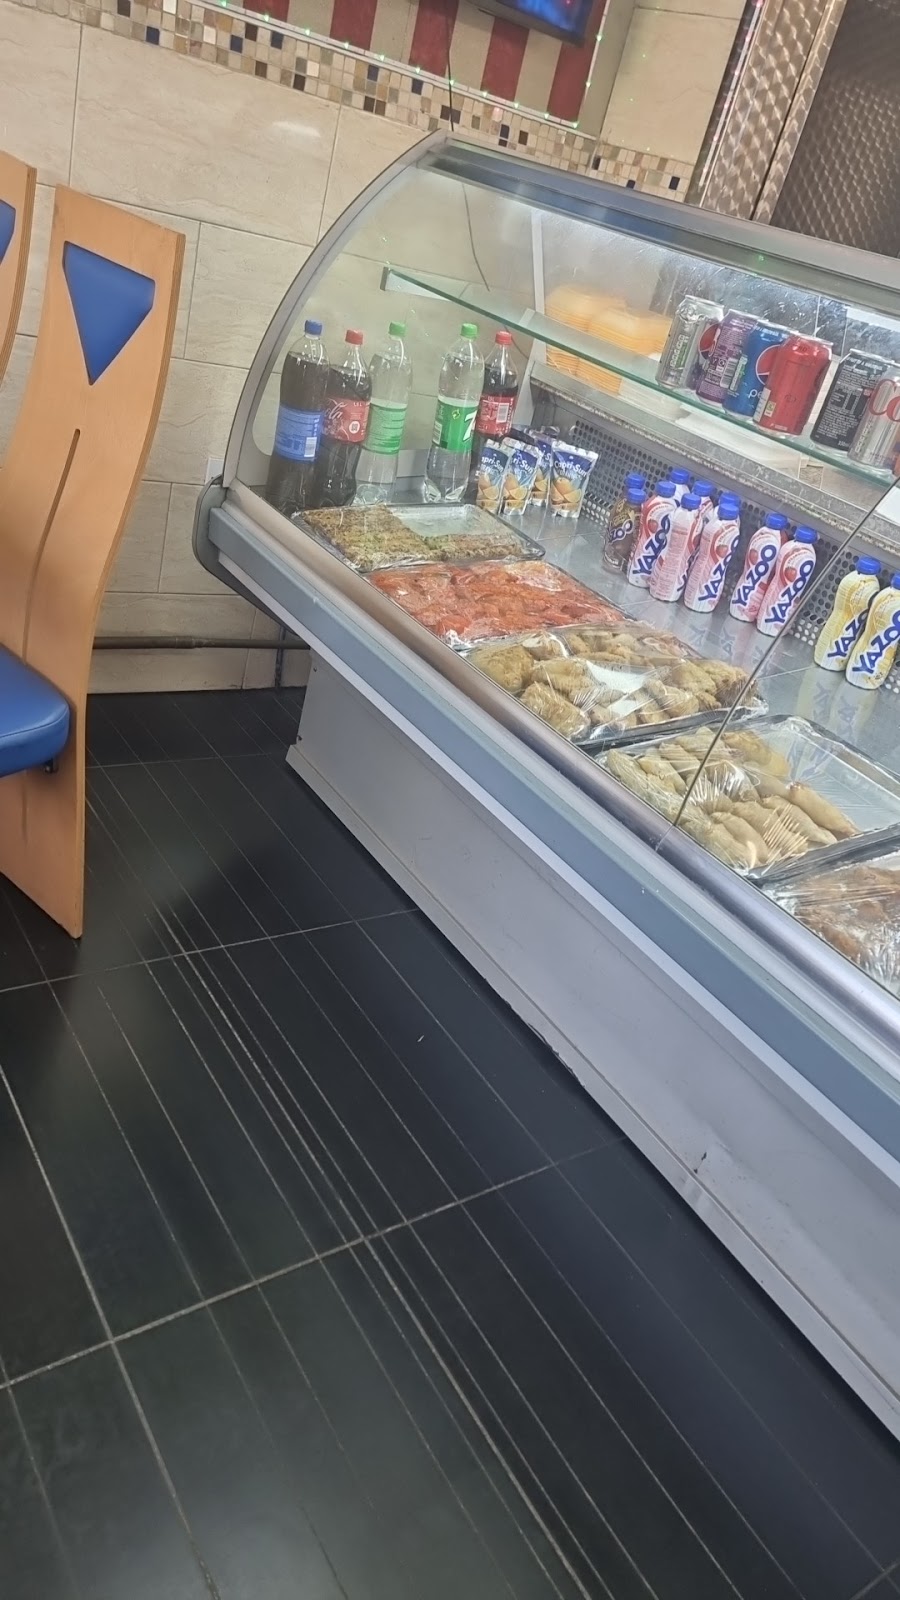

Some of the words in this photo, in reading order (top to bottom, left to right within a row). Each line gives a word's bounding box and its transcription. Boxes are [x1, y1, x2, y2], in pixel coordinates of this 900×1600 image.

[632, 514, 670, 575] YAZOO
[731, 544, 777, 607] YAZOO
[764, 559, 815, 624] YAZOO
